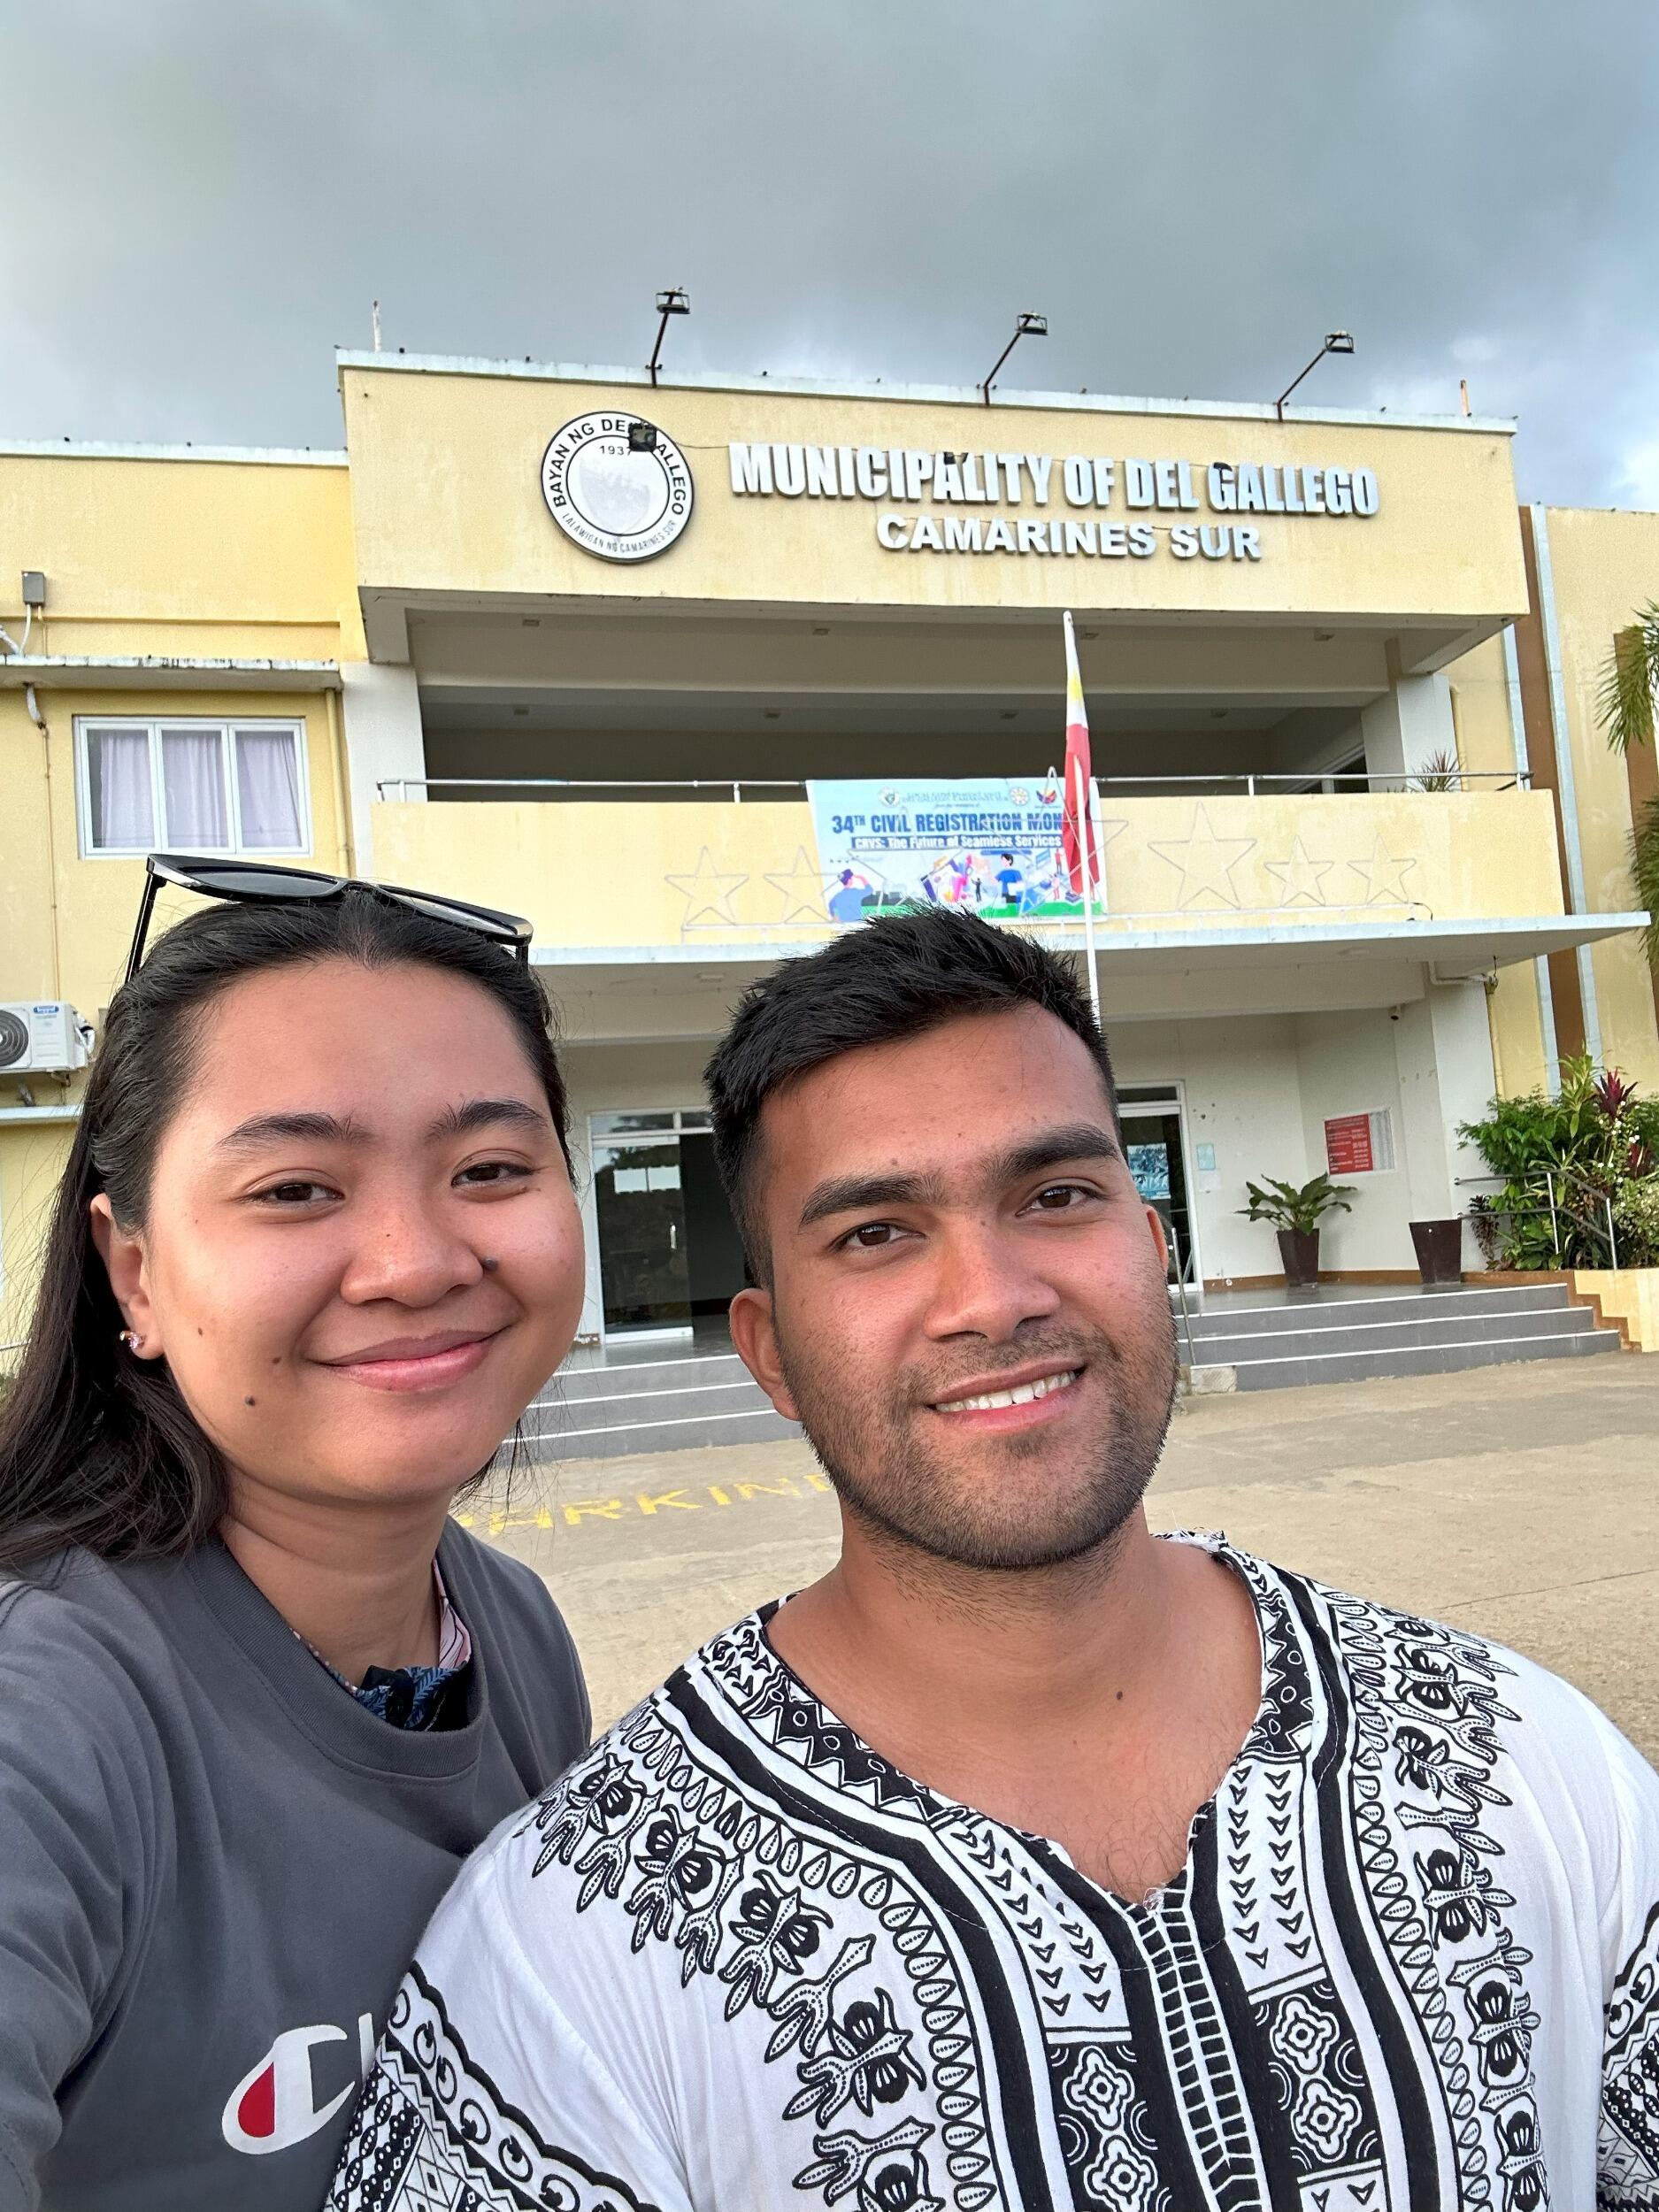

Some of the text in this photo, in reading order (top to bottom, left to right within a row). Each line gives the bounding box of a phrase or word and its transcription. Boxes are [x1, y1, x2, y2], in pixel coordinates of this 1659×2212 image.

[549, 444, 570, 508] BAYAN
[567, 422, 595, 444] NG
[656, 443, 687, 516] ALLEGO
[729, 442, 1380, 518] MUNICIPALITY OF DEL GALLEGO
[876, 513, 1263, 561] CAMARINES SUR
[871, 813, 911, 833] CIVIL
[915, 812, 1023, 833] REGISTRATION
[1026, 812, 1063, 831] MON
[910, 836, 946, 849] Future
[960, 834, 1013, 849] Seamless
[1015, 834, 1062, 848] Services
